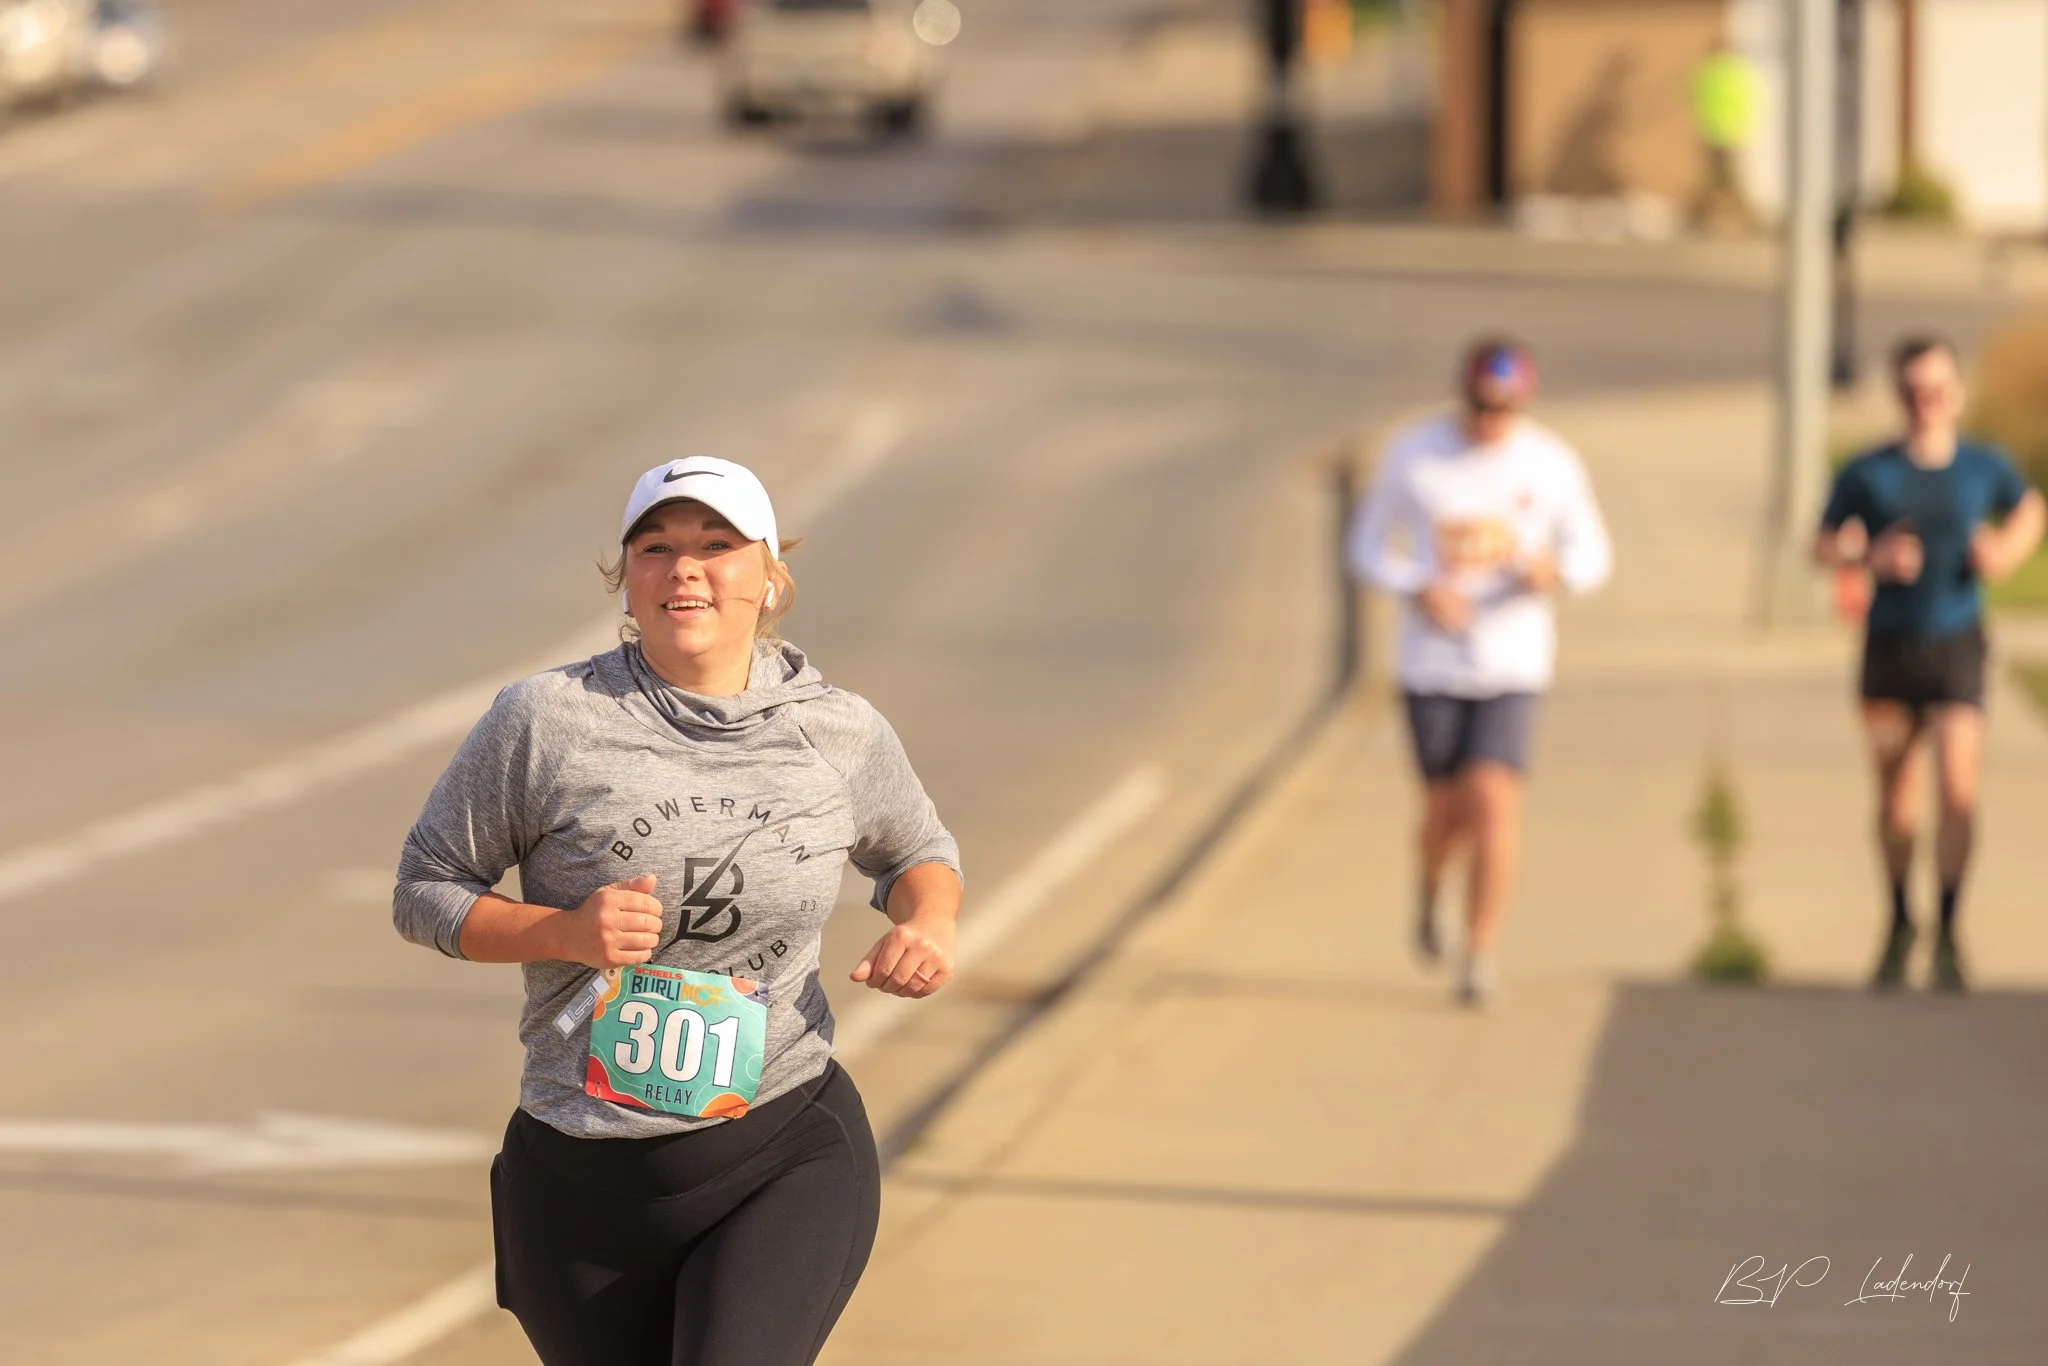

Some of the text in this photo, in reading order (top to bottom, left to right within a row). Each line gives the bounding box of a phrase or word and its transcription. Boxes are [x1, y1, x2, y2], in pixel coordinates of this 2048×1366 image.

[611, 796, 811, 865] BOWERMAN
[634, 966, 683, 981] SCHEELS
[614, 1000, 740, 1088] 301
[645, 1083, 694, 1106] RELAY
